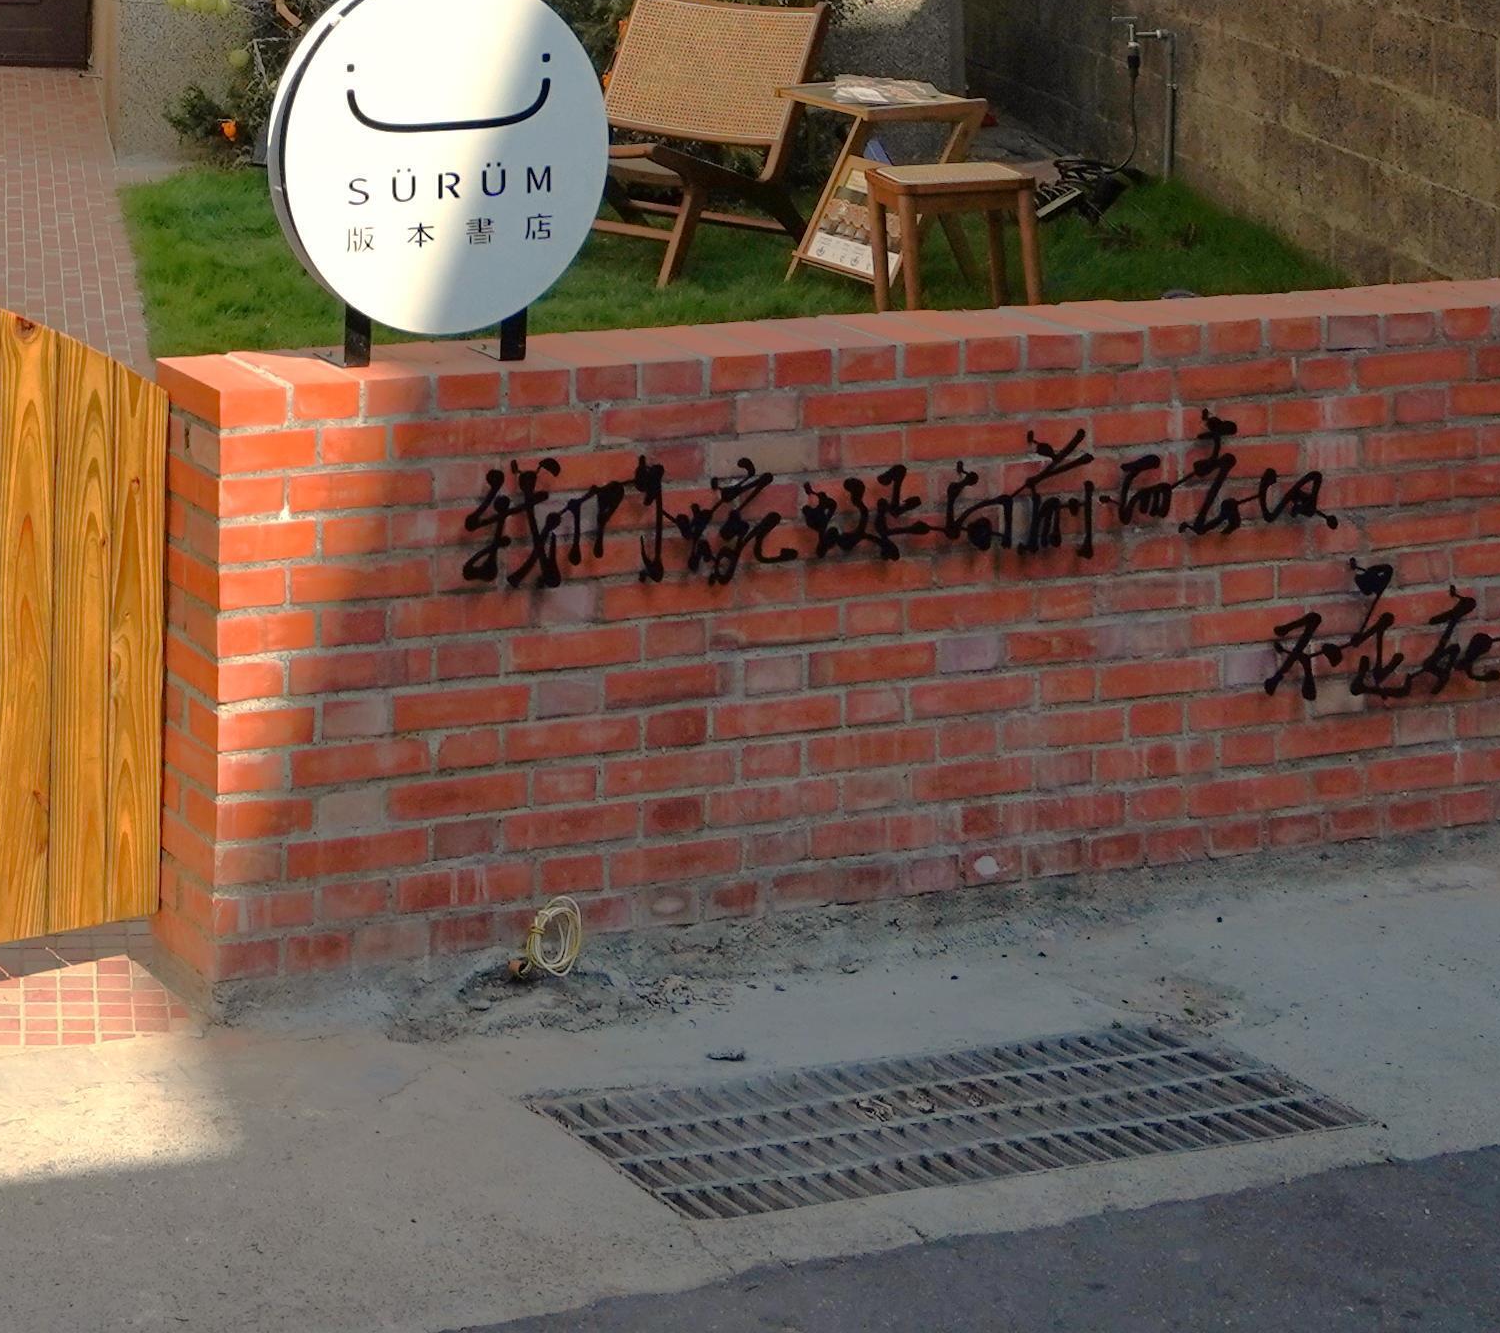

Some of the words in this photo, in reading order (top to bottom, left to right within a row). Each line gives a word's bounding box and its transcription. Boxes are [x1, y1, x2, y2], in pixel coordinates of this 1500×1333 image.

[347, 162, 552, 206] SÜRÜM
[346, 213, 553, 253] 版本書店
